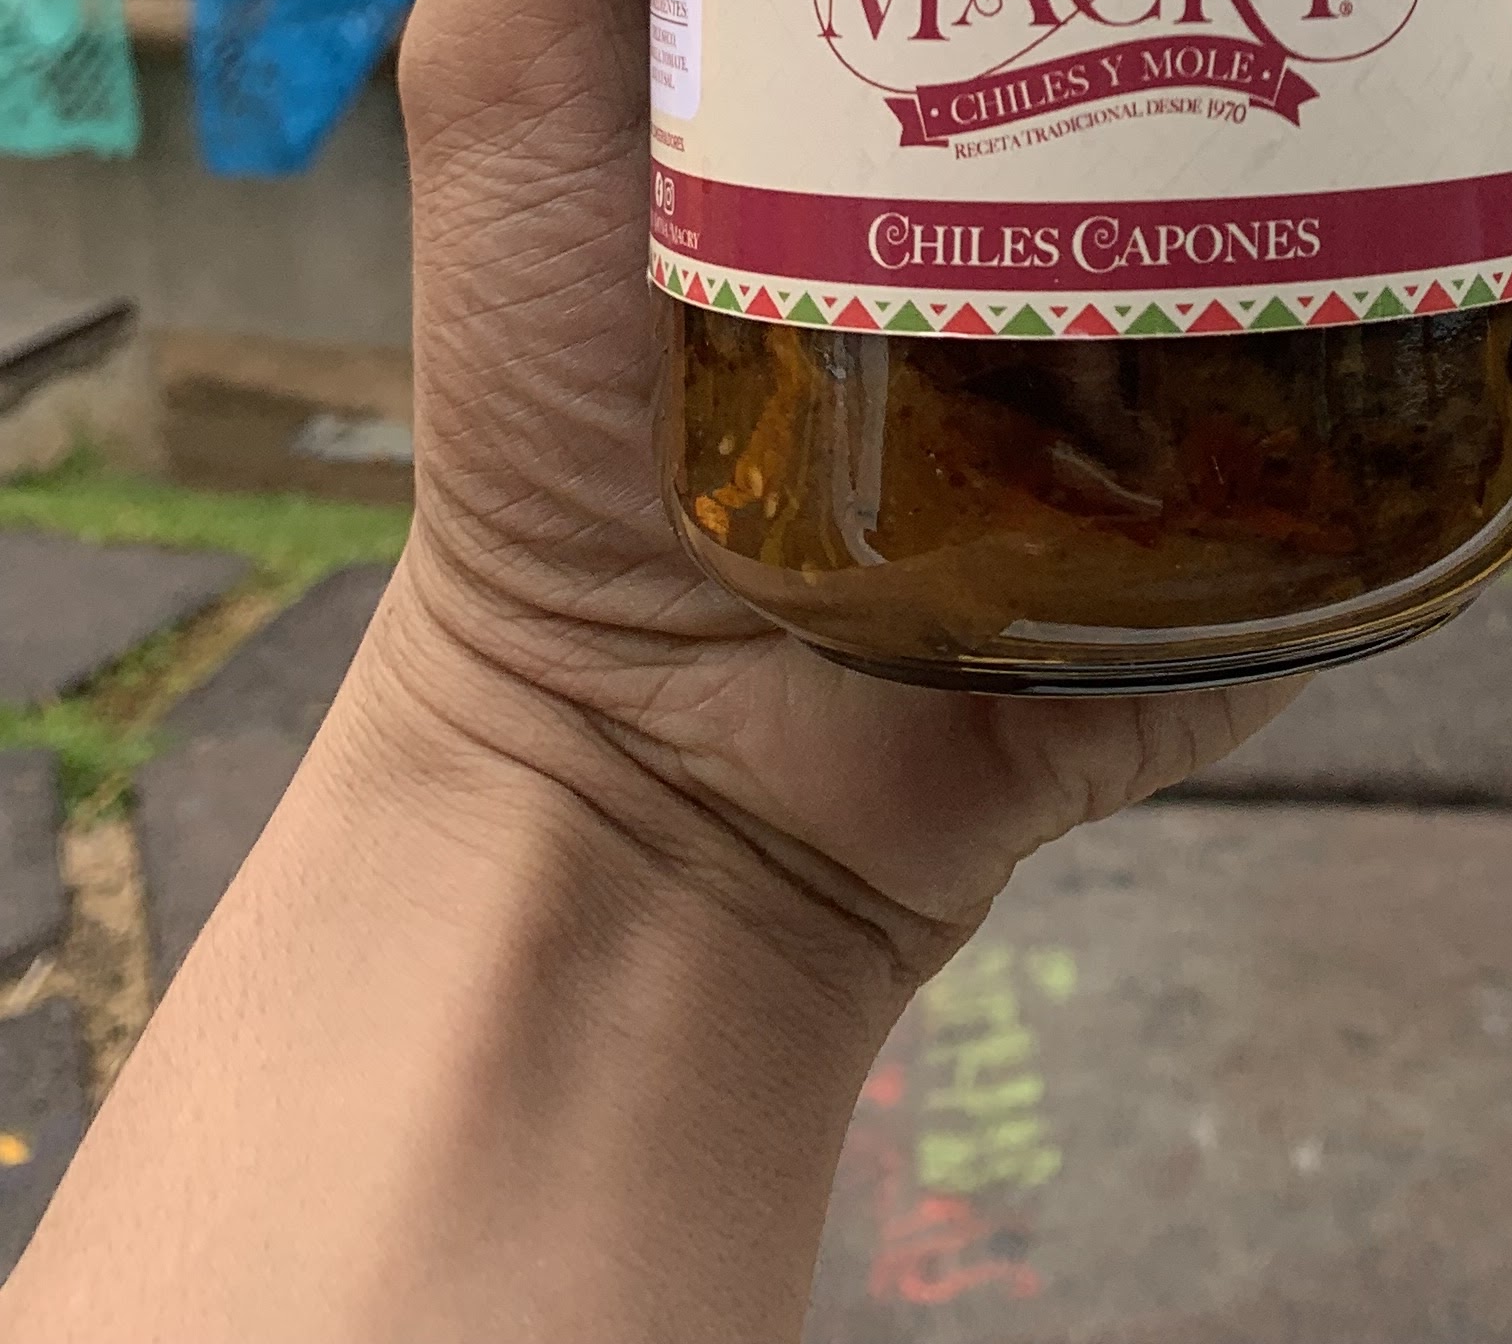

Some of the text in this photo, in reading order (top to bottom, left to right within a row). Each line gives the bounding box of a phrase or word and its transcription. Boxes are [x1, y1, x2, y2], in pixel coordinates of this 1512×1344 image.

[950, 45, 1256, 126] CHILES Y MOLE
[954, 96, 1248, 160] RECETA TRADICIONAL DESDE 1970
[868, 211, 1322, 275] CHILES CAPONES
